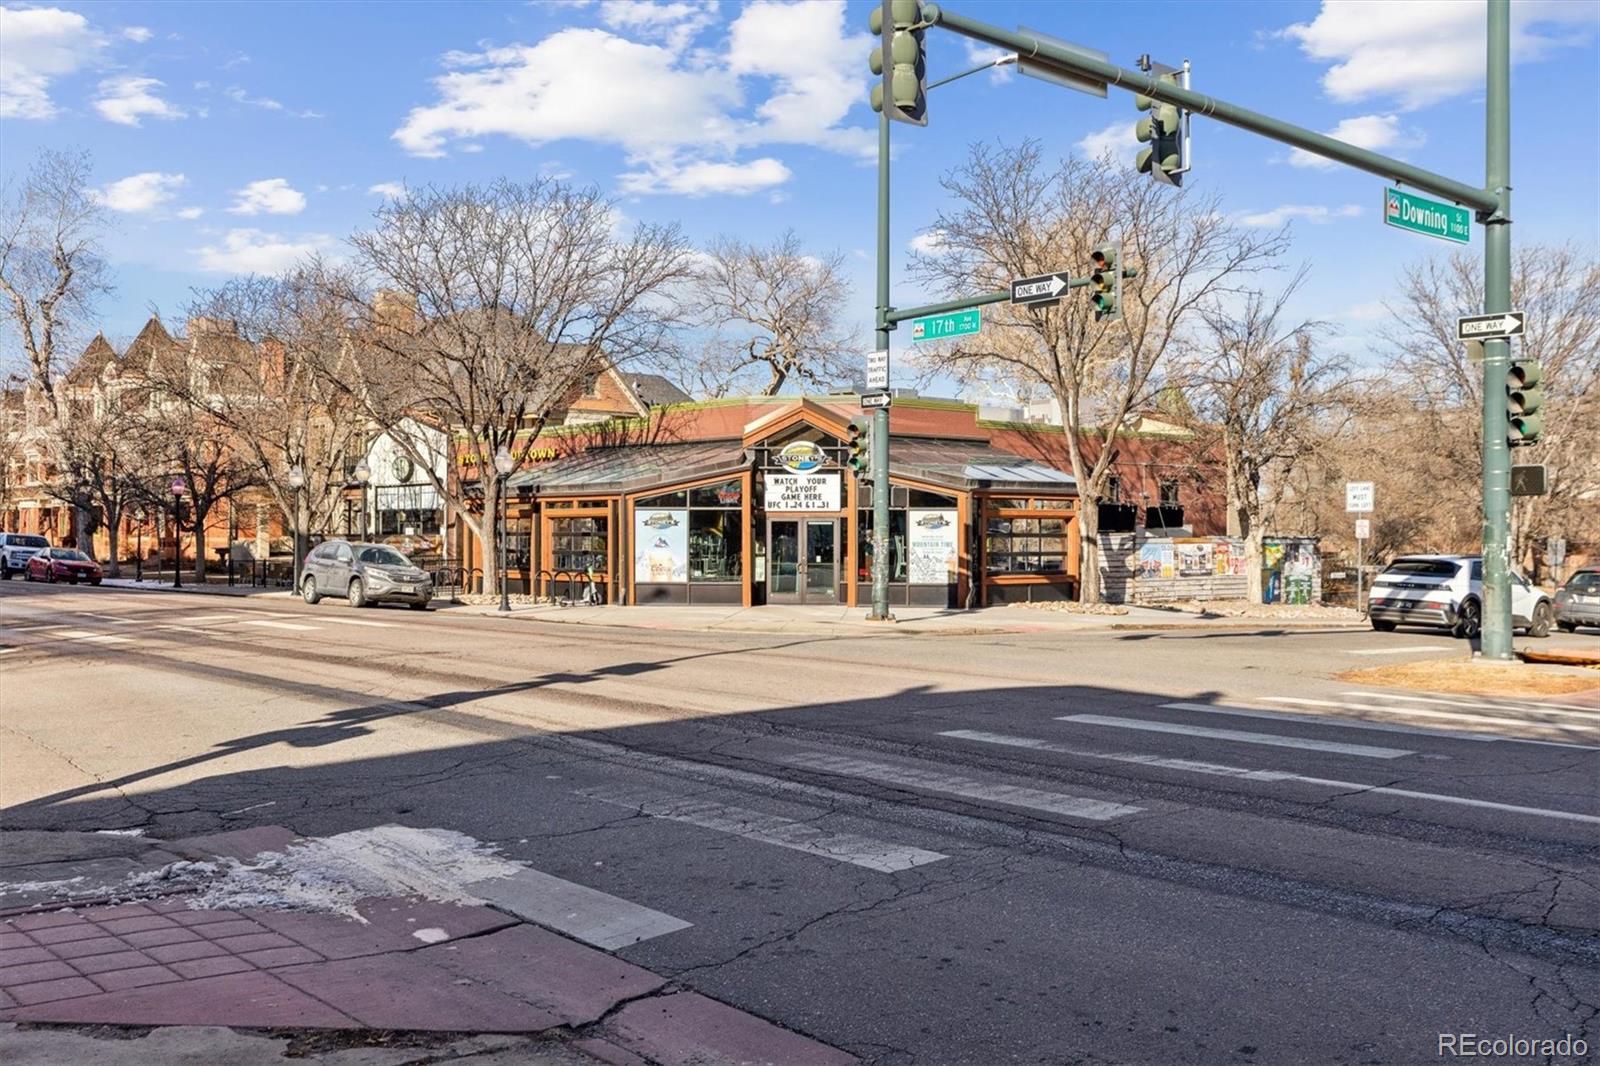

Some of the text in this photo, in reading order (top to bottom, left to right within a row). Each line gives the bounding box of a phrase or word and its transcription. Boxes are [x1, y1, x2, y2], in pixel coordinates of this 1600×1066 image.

[1402, 198, 1448, 235] Downing
[1017, 282, 1052, 297] ONE WAY
[932, 319, 955, 335] 17th
[1465, 320, 1504, 332] ONE WAY
